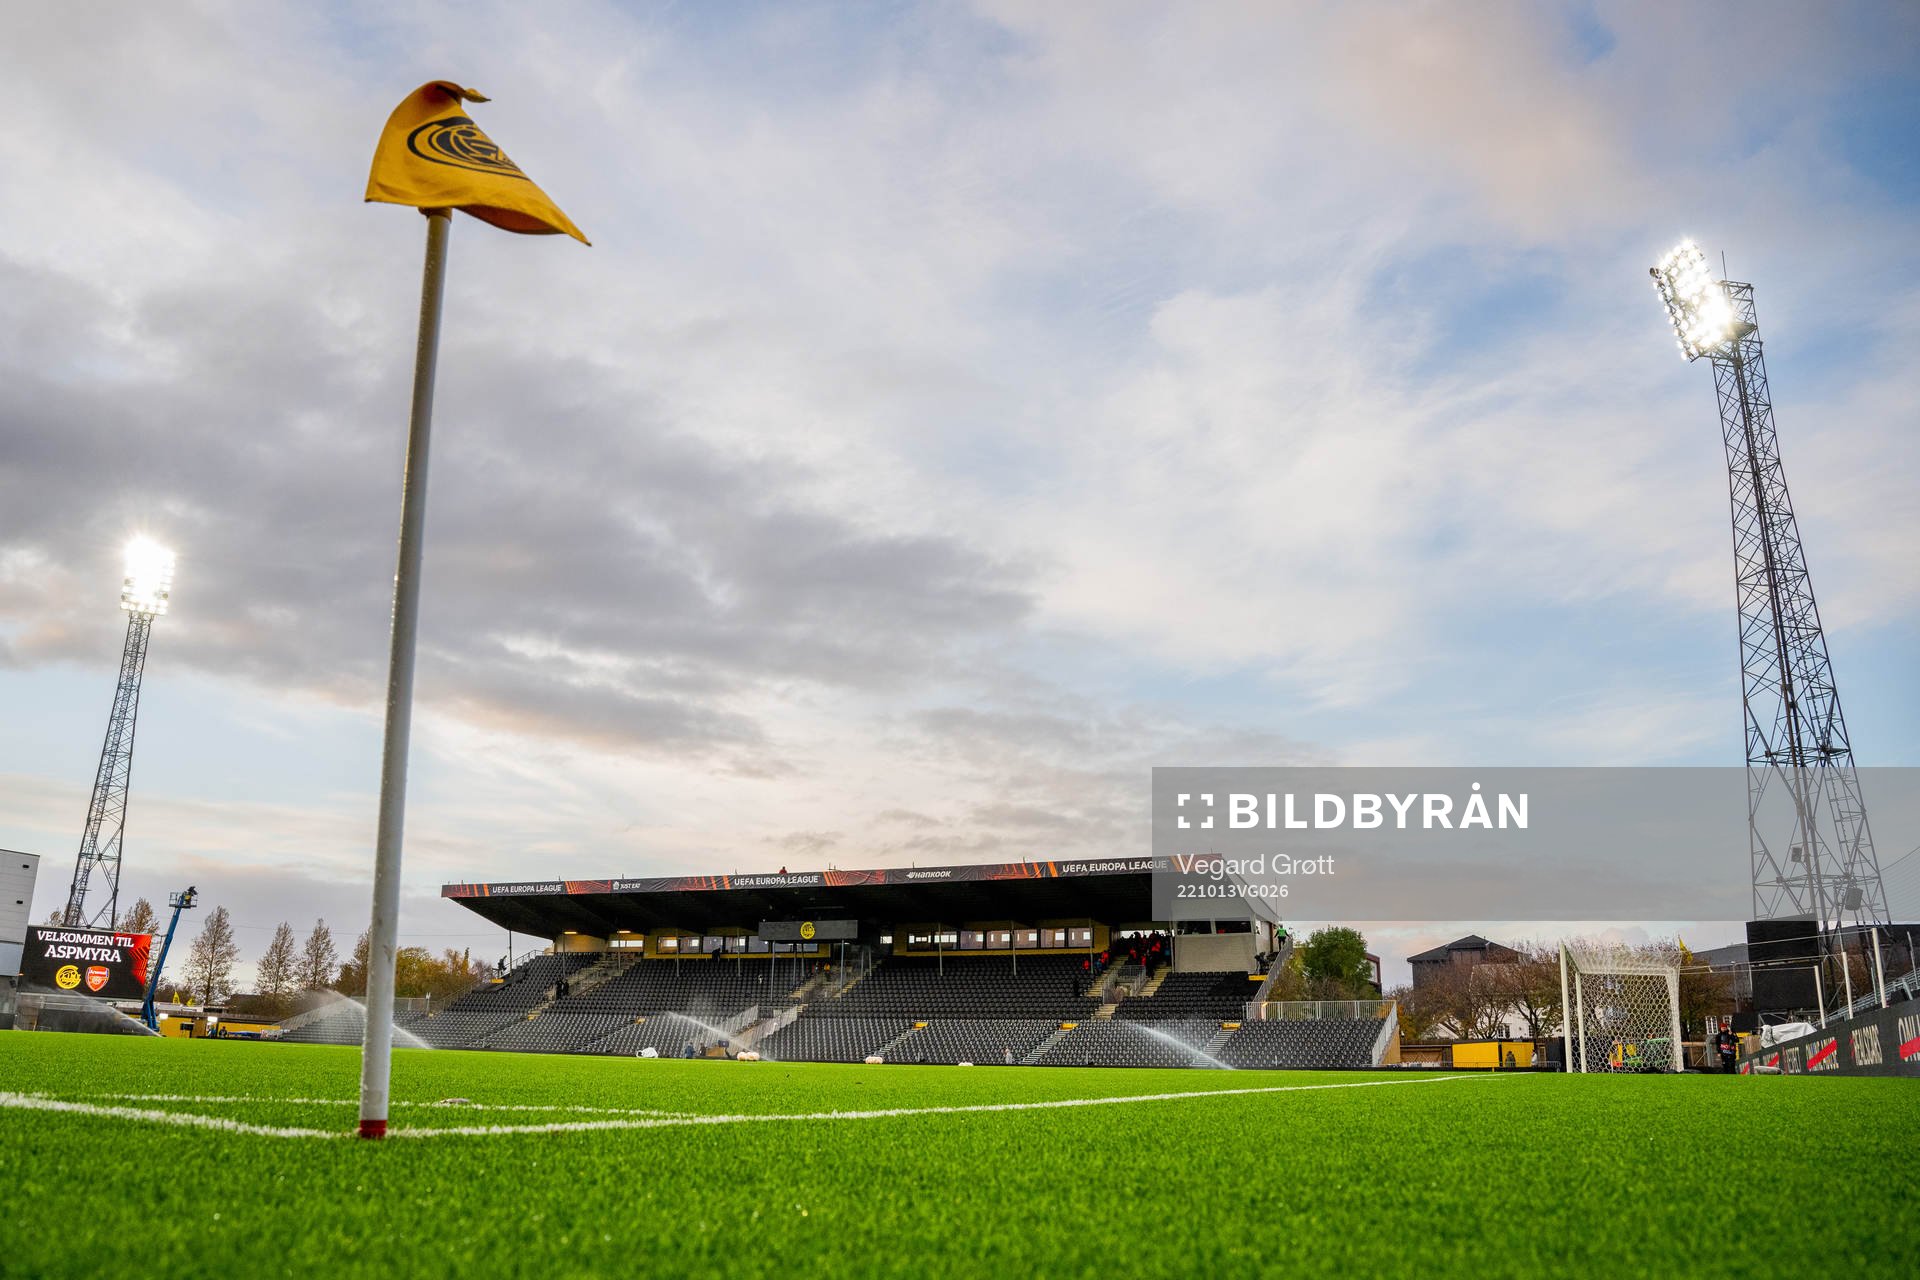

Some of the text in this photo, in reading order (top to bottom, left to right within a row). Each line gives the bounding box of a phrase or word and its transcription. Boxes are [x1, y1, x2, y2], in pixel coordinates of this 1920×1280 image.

[1062, 860, 1167, 873] UEFA EUROPA LEAGUE
[734, 876, 819, 886] UEFA EUROPA LEAGUE
[492, 884, 562, 894] UEFA EUROPA LEAGUE
[37, 930, 135, 948] VELKOMMEN TIL
[44, 945, 122, 962] ASPMYRA
